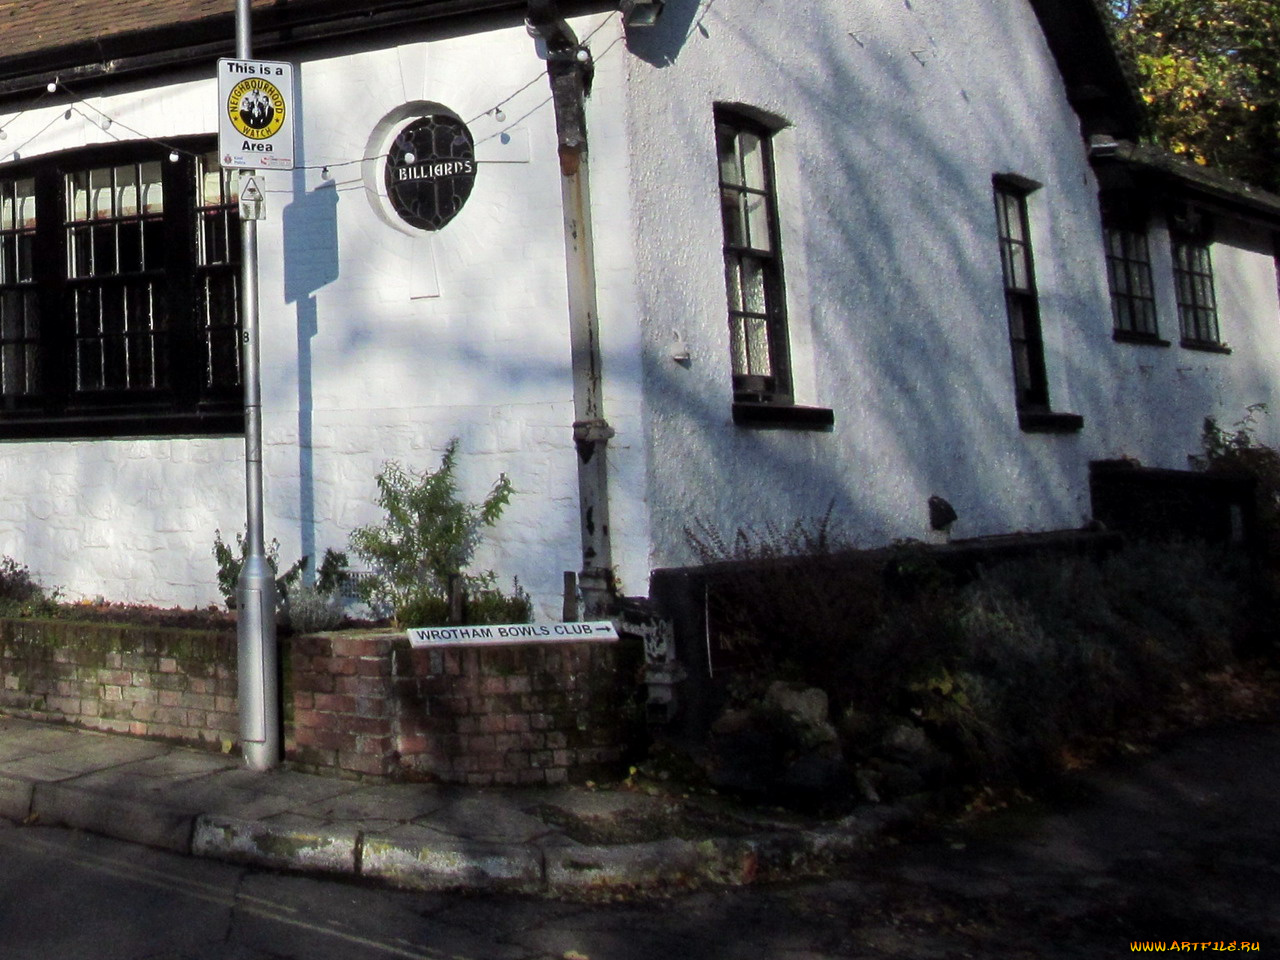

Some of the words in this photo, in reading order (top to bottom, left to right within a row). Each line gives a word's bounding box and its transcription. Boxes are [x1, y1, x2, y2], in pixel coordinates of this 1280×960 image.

[227, 62, 256, 74] This
[260, 64, 271, 75] is
[275, 67, 283, 76] a
[230, 79, 283, 114] NEIGHBOURHOOD
[242, 126, 272, 137] WATCH
[242, 140, 273, 152] Area
[399, 160, 473, 181] BILLIARDS
[417, 627, 493, 641] WROTHAM
[498, 625, 550, 638] BOWLS
[554, 624, 593, 635] CLUB
